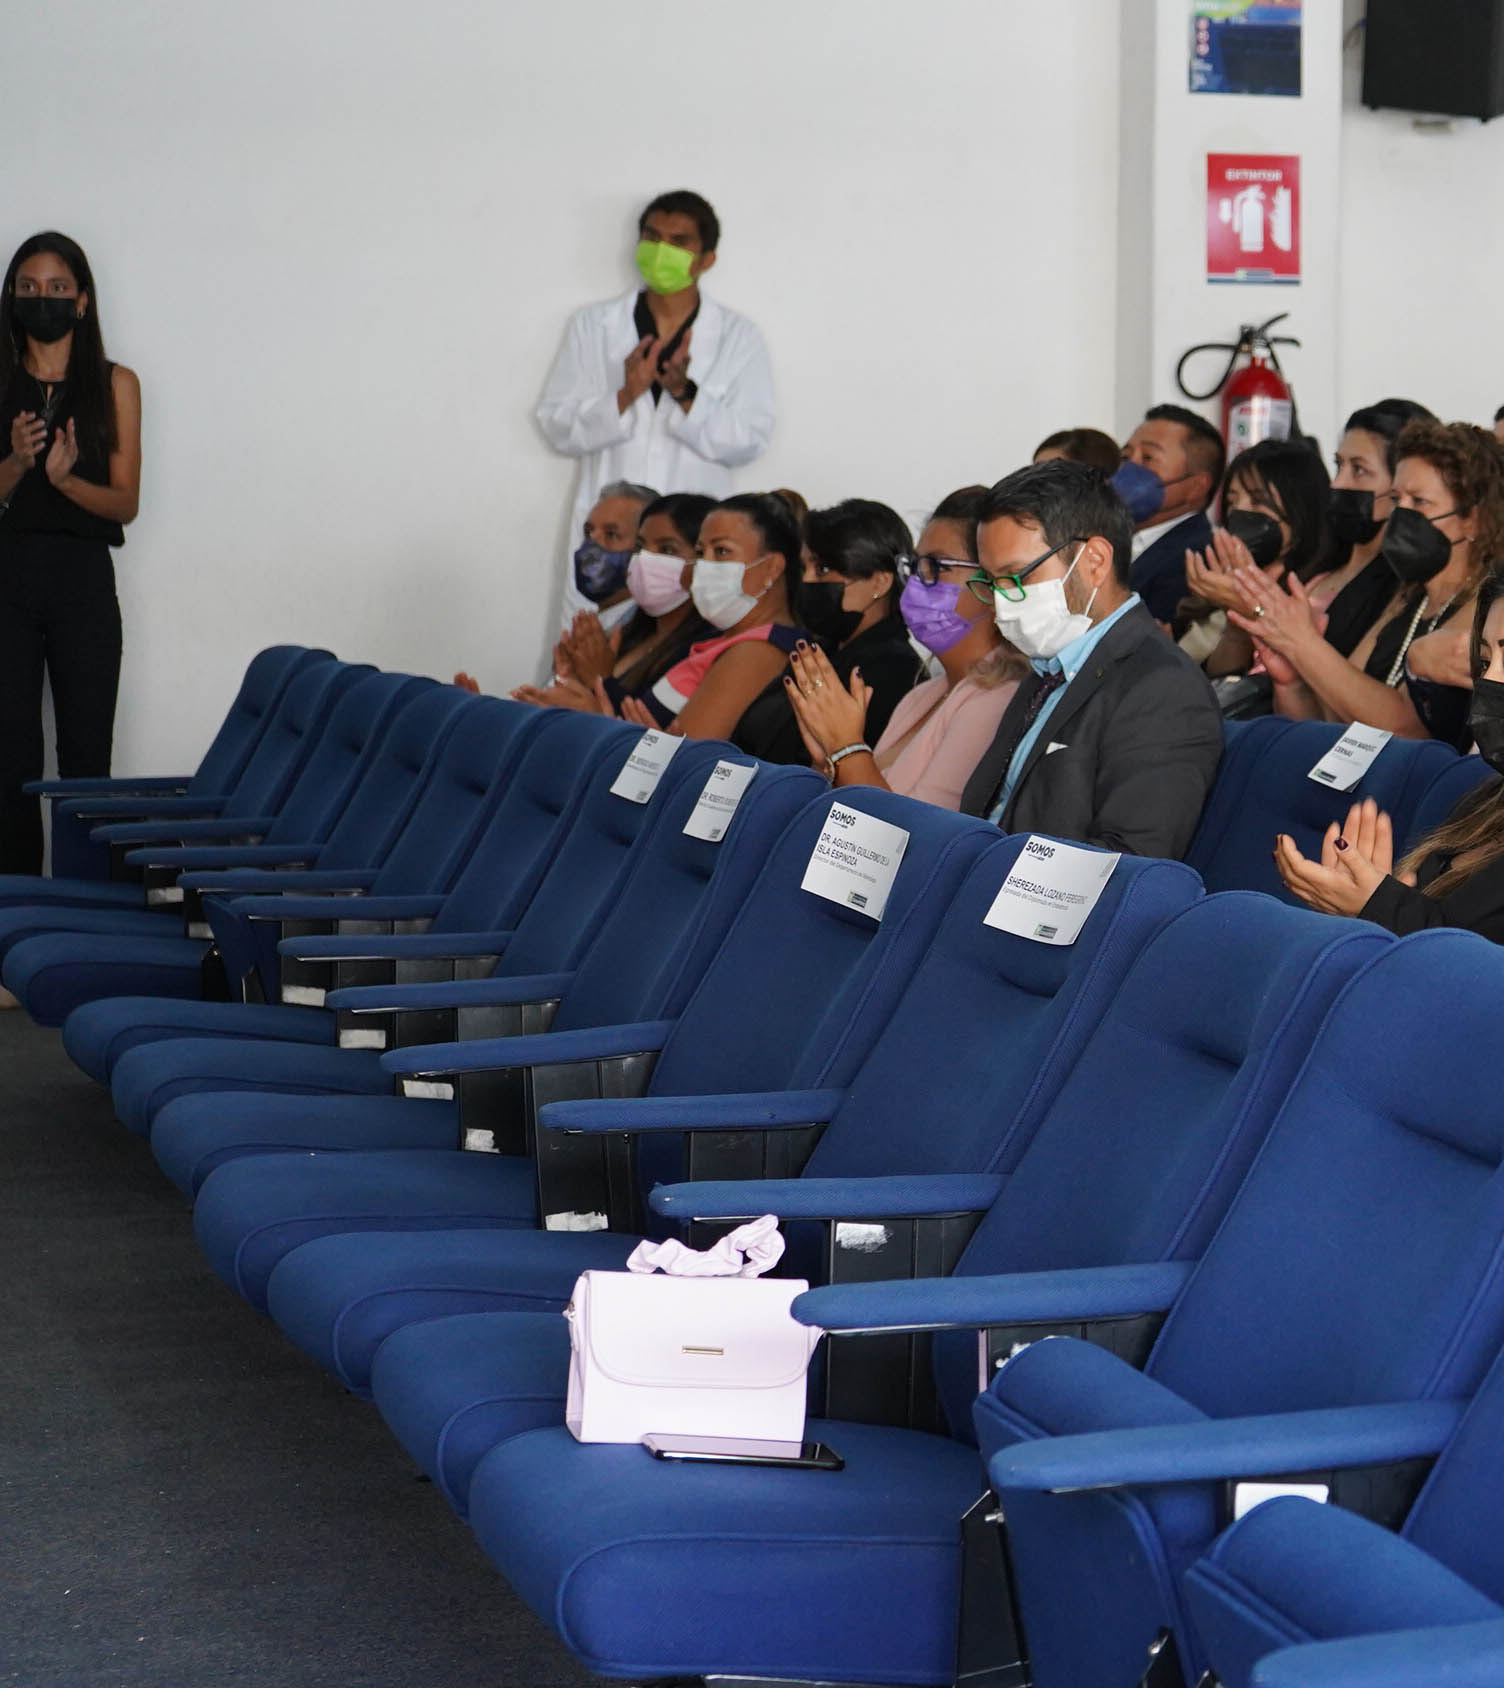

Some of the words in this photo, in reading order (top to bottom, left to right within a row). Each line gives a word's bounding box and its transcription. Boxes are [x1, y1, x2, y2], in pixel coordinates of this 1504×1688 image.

[1225, 168, 1282, 181] EXTINTOR
[830, 808, 857, 827] SOMOS
[816, 843, 831, 856] ISLA
[830, 849, 858, 867] ESPINOZA
[1025, 841, 1056, 859] SOMOS
[1006, 875, 1045, 897] SHEREZADA
[1043, 887, 1067, 902] LOZANO
